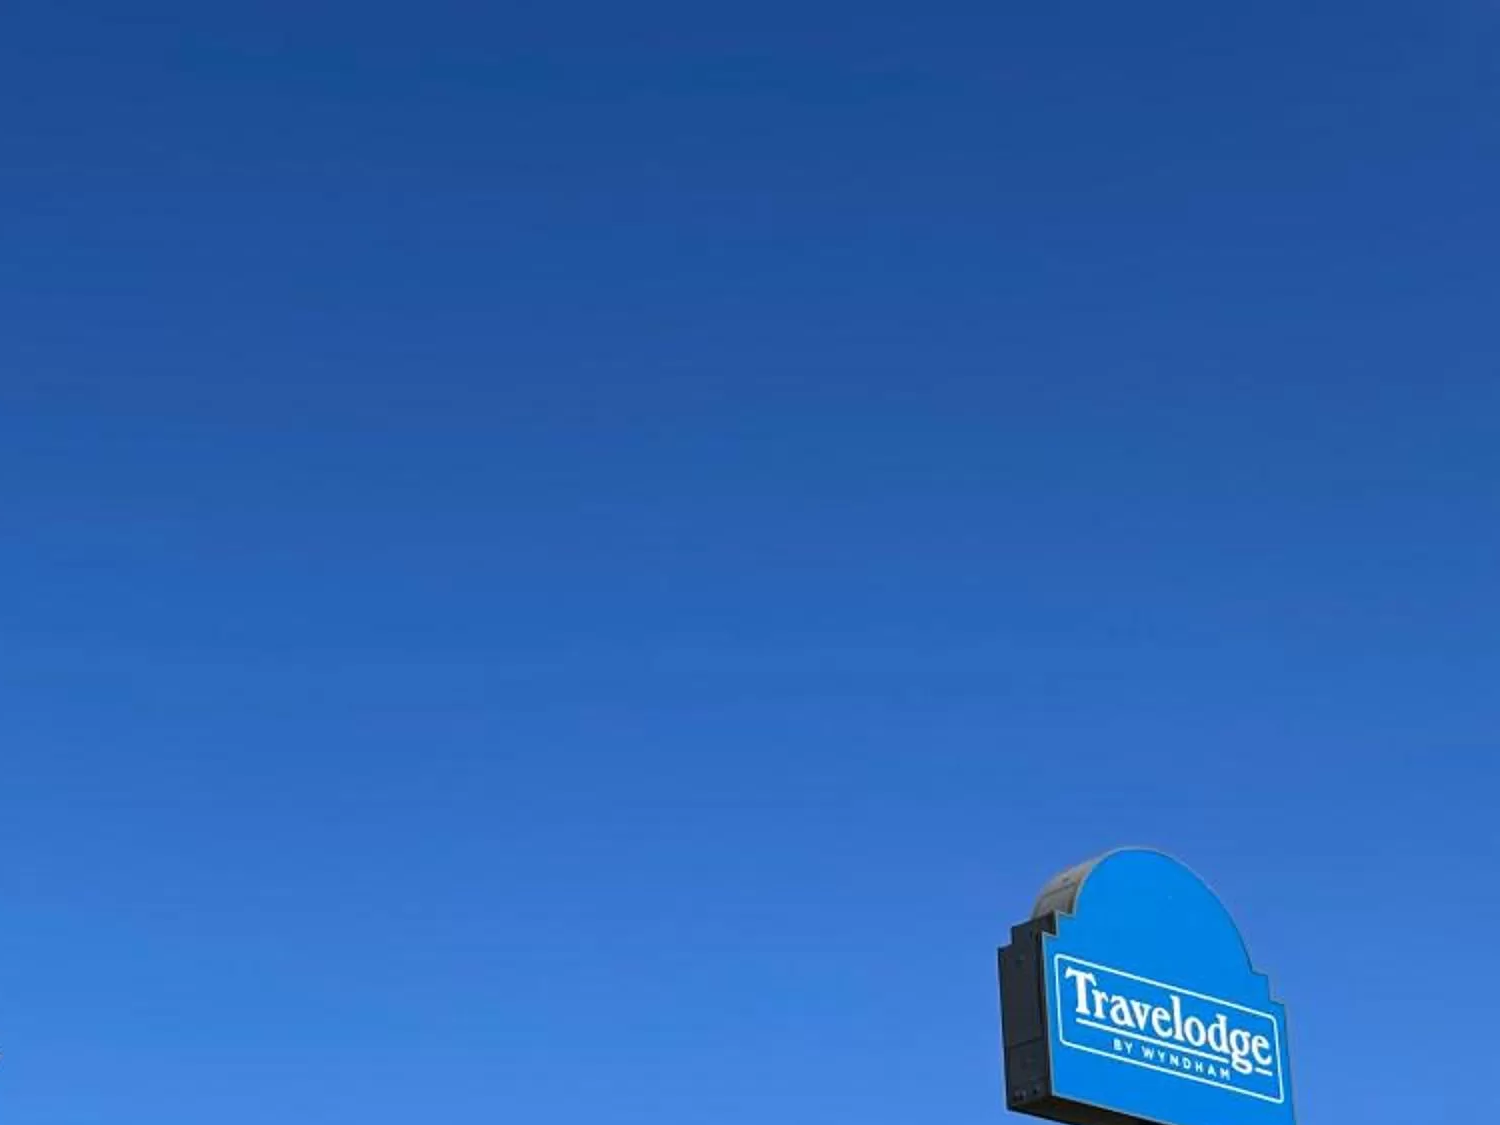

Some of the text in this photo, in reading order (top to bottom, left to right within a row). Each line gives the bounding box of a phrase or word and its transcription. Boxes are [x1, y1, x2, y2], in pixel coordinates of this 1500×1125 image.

[1064, 966, 1273, 1075] Travelodge
[1112, 1038, 1231, 1081] BY WYNDHAM
